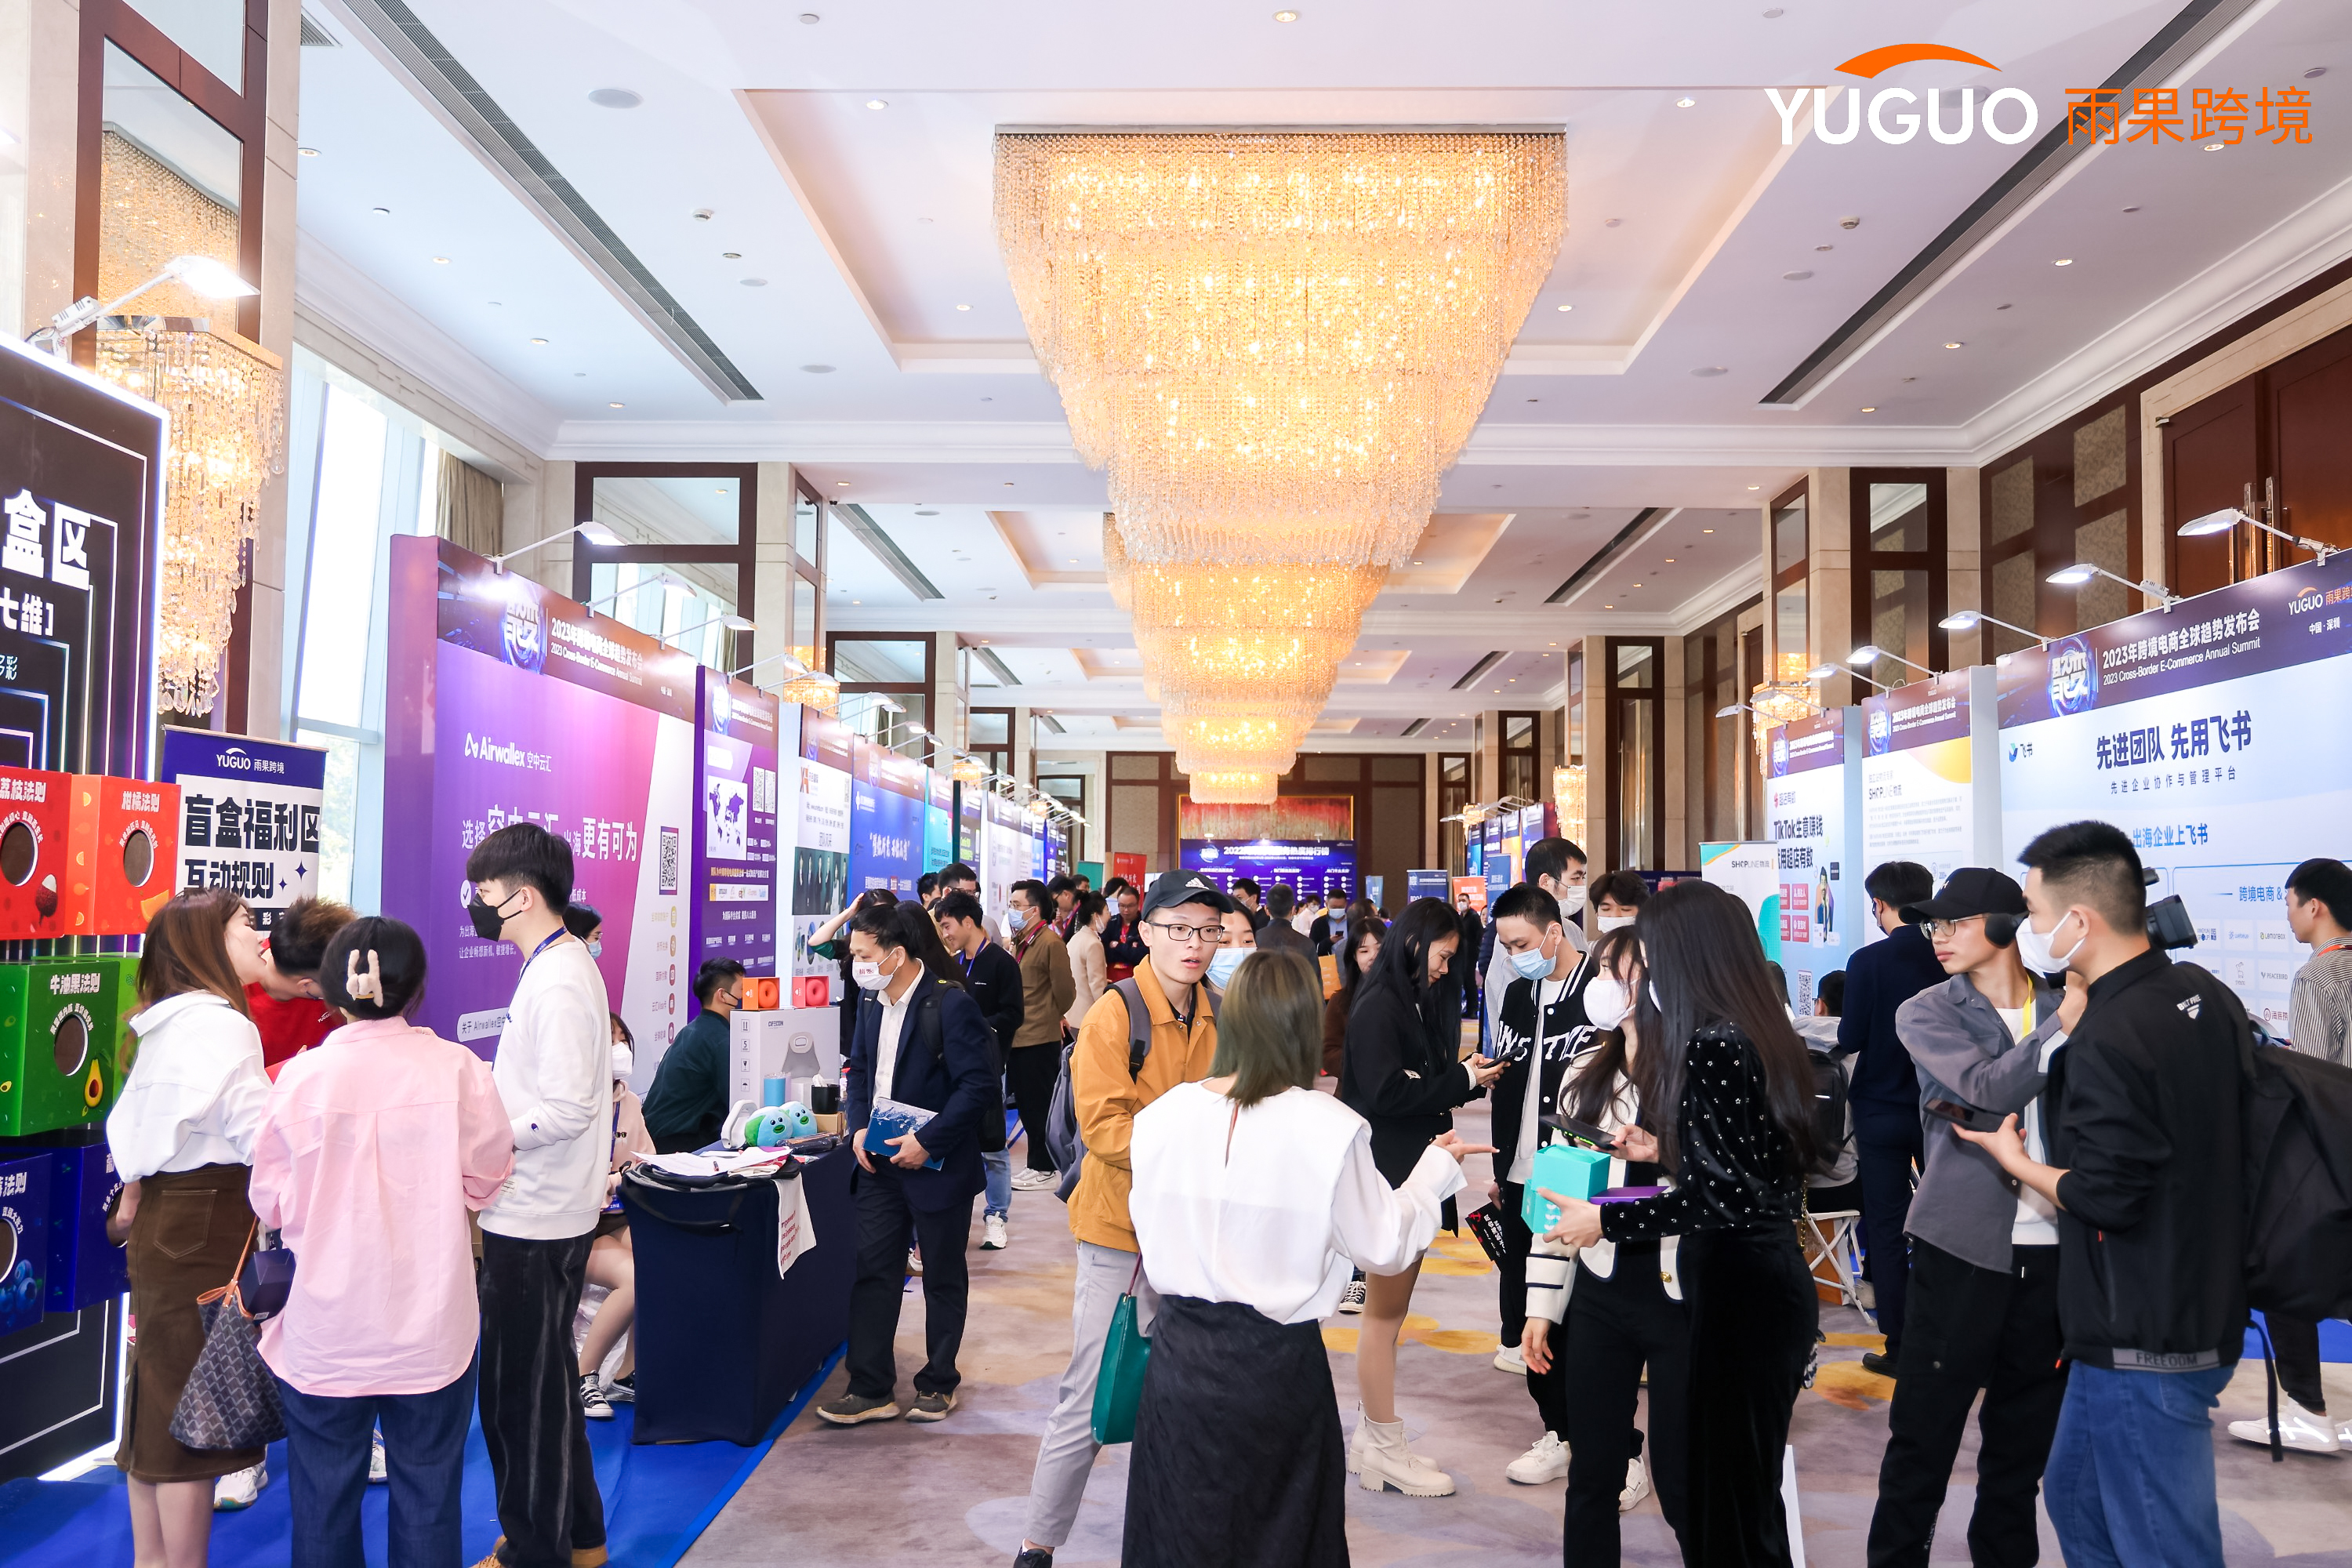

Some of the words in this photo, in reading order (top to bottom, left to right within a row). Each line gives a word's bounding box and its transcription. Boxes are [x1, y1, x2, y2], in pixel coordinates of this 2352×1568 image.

[2288, 593, 2324, 615] YUGUO
[2325, 586, 2352, 606] 雨果跨
[2102, 608, 2260, 670] 2023年跨境电商全球趋势发布会
[2103, 673, 2118, 686] 2023
[2119, 662, 2159, 682] Cross-Border
[2160, 652, 2204, 672] E-Commerce
[2205, 644, 2230, 662] Annual
[2231, 636, 2261, 655] Summit
[479, 735, 526, 768] Airwallex
[526, 750, 552, 772] 空中云汇
[2020, 741, 2033, 758] 飞书
[2096, 725, 2165, 771] 先进团队
[2170, 710, 2252, 760] 先用飞书
[216, 753, 252, 771] YUGUO
[253, 758, 285, 775] 雨果跨境
[0, 777, 47, 803] 荔枝法则
[2111, 765, 2237, 795] 先进企业协作与管理平台
[122, 790, 160, 813] 柑橘法则
[185, 793, 321, 854] 盲盒福利区
[2132, 822, 2209, 848] 出海企业上飞书
[184, 858, 274, 899] 互动规则
[2239, 885, 2274, 902] 跨境电商
[2276, 886, 2283, 901] &
[49, 972, 101, 995] 牛油果法则
